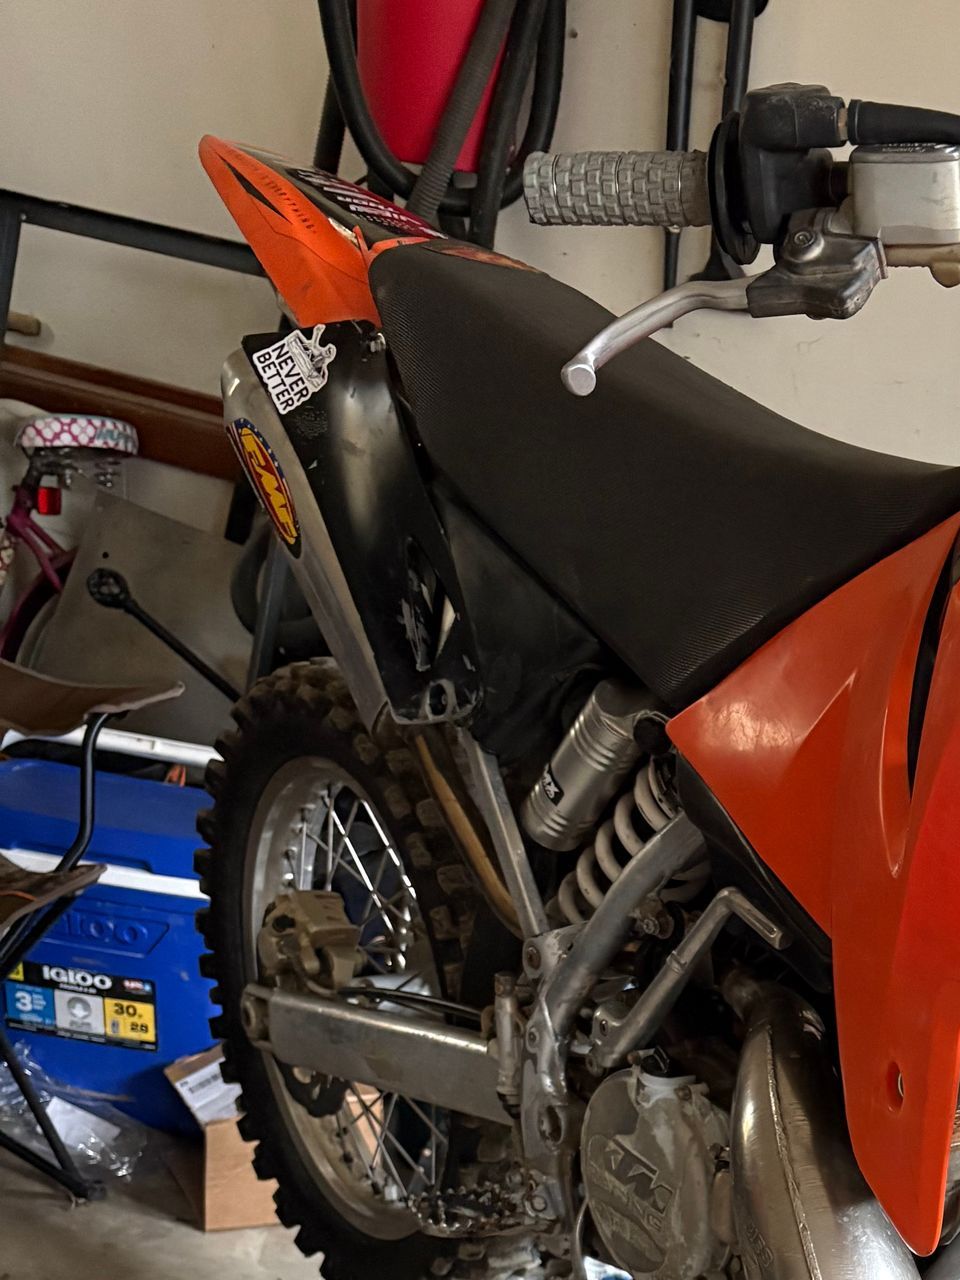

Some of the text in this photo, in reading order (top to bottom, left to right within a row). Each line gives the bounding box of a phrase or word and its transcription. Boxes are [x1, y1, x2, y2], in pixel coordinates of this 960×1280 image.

[256, 351, 296, 411] BETTER
[271, 342, 309, 403] NEVER
[239, 426, 298, 545] FMF
[42, 965, 113, 990] IGLOO
[15, 990, 33, 1012] 3
[114, 1002, 137, 1018] 30
